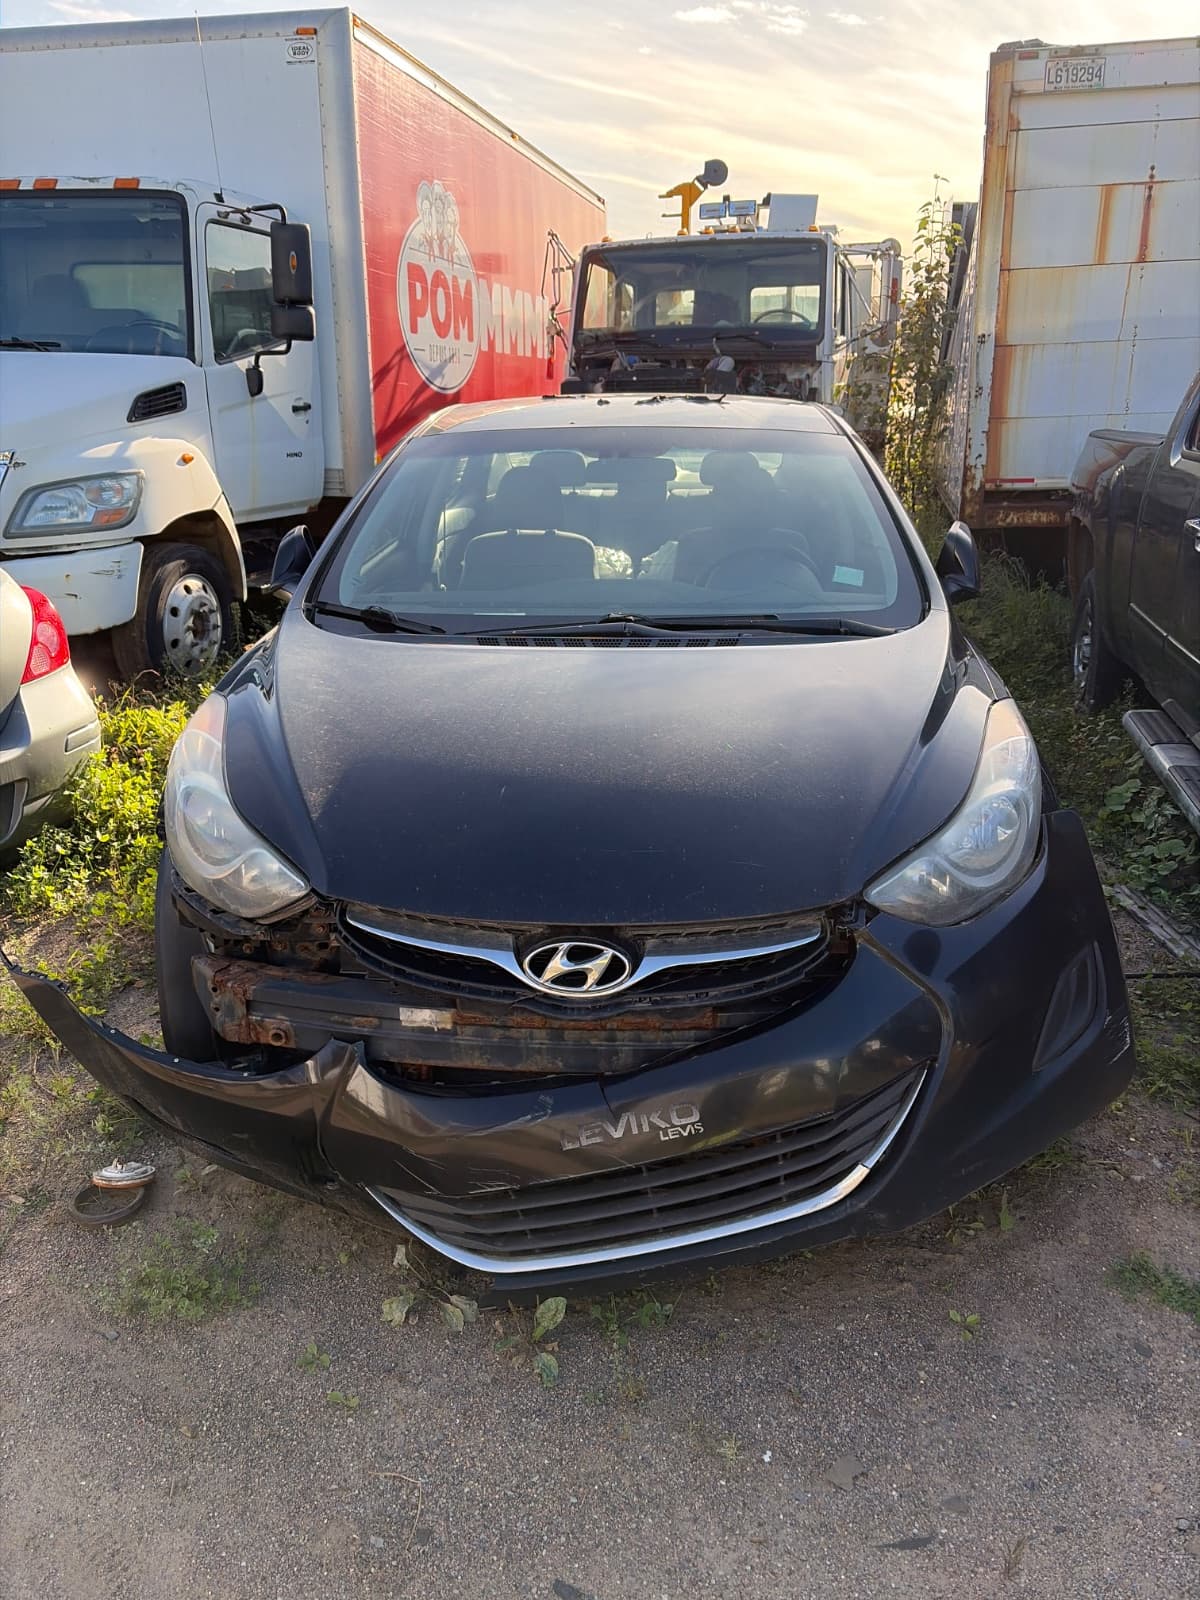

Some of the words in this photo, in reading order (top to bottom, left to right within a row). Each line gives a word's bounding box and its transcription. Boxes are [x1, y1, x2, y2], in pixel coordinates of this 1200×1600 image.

[1047, 65, 1102, 84] L619294
[407, 262, 474, 343] POM
[659, 1122, 704, 1142] LEVIS
